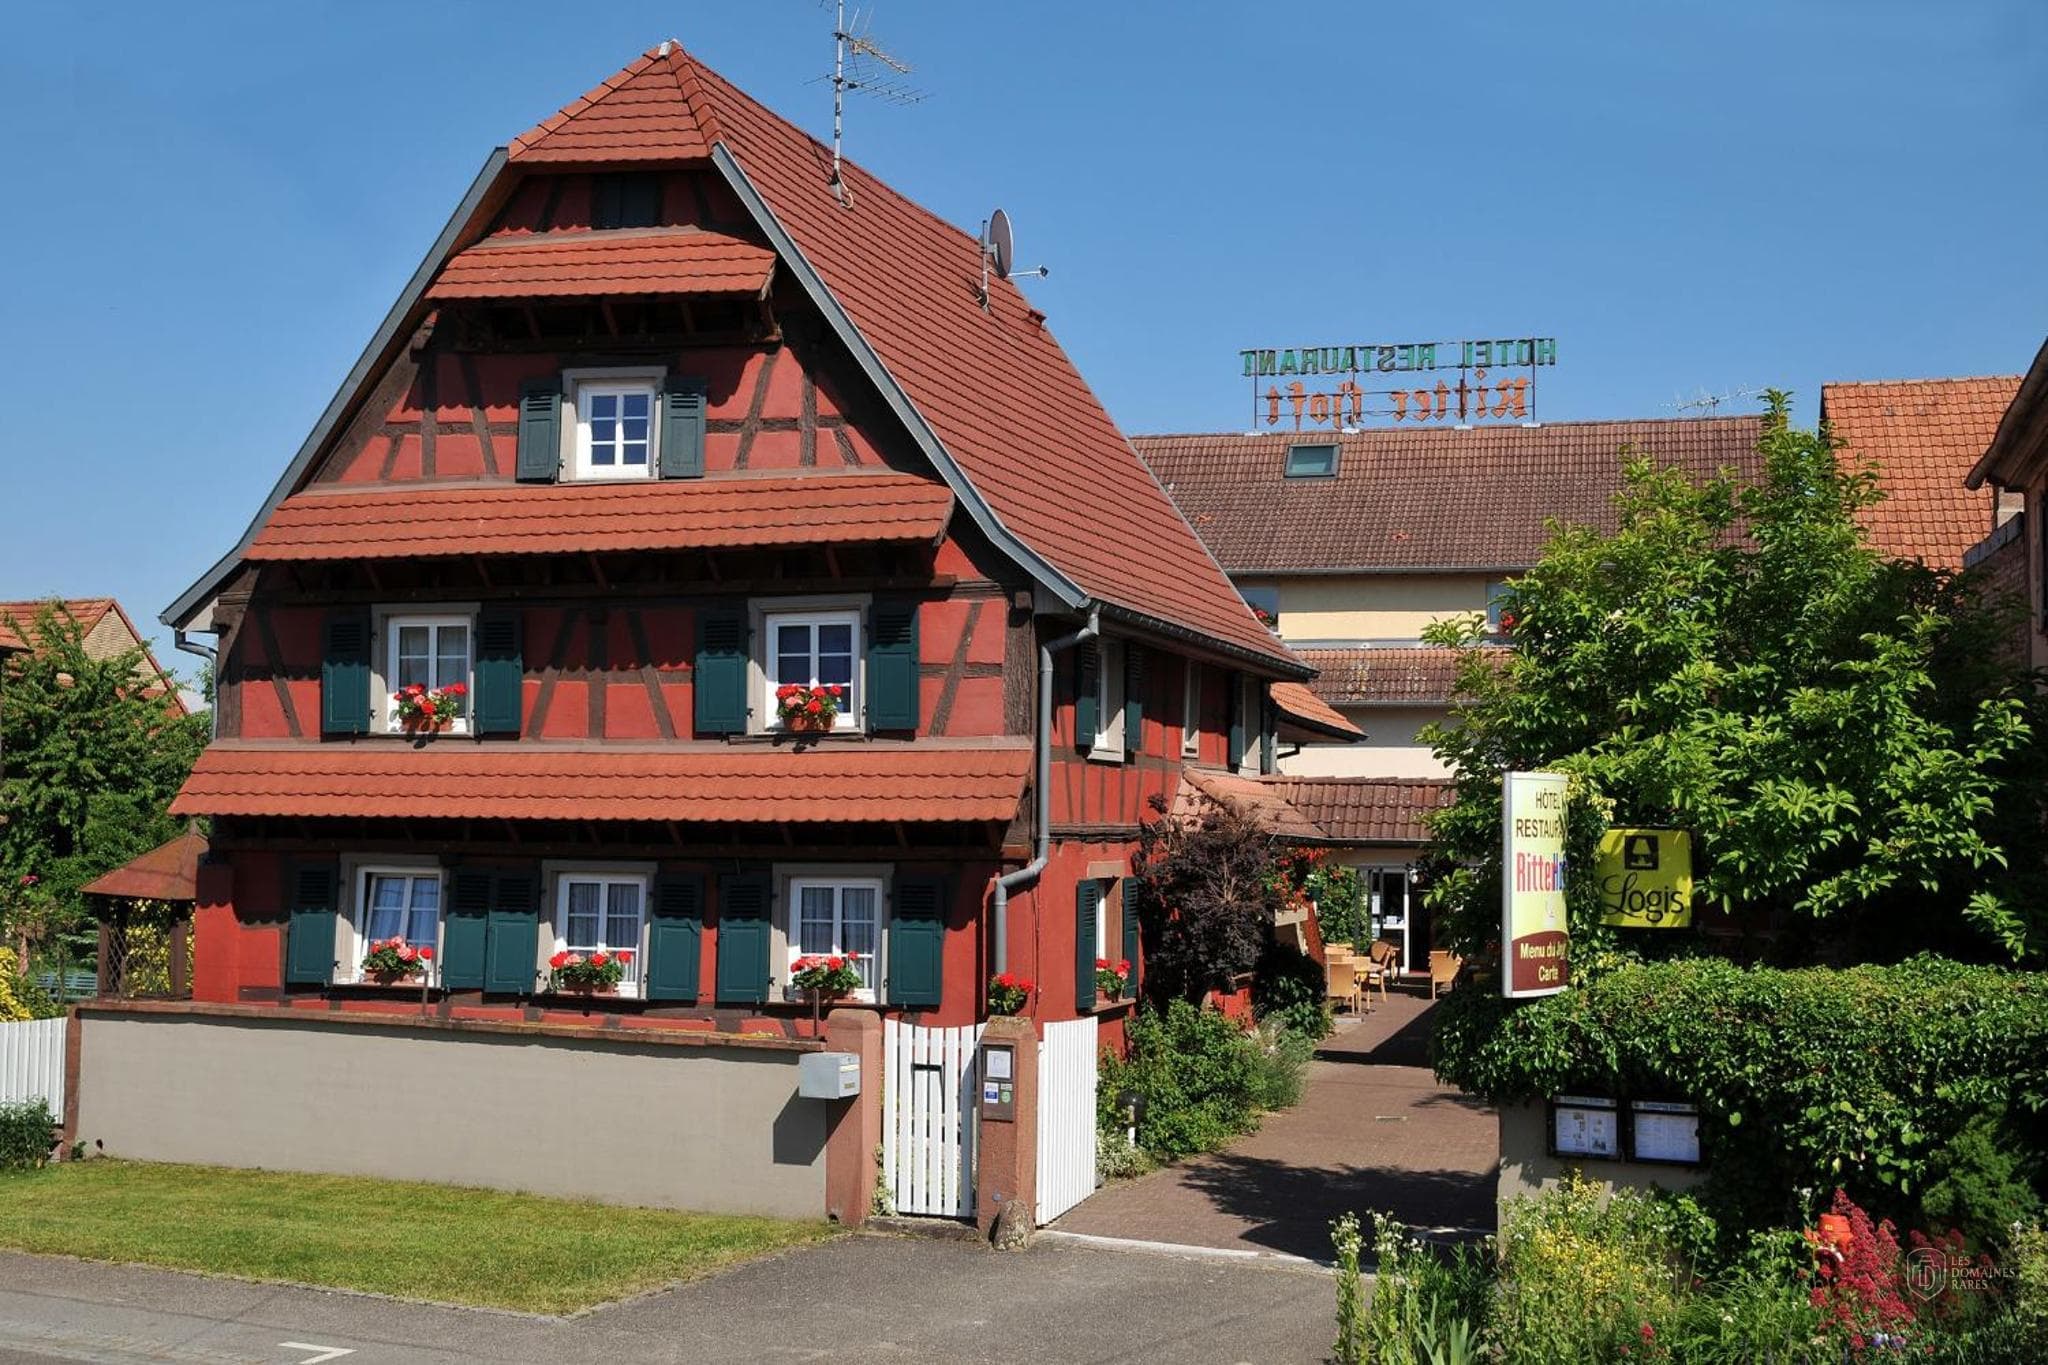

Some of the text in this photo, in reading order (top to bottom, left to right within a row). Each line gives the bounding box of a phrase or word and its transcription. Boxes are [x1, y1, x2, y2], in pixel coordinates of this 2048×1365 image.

[1601, 871, 1685, 924] Logis
[1520, 943, 1545, 960] Menu
[1546, 941, 1556, 957] du
[1538, 965, 1559, 982] Carte
